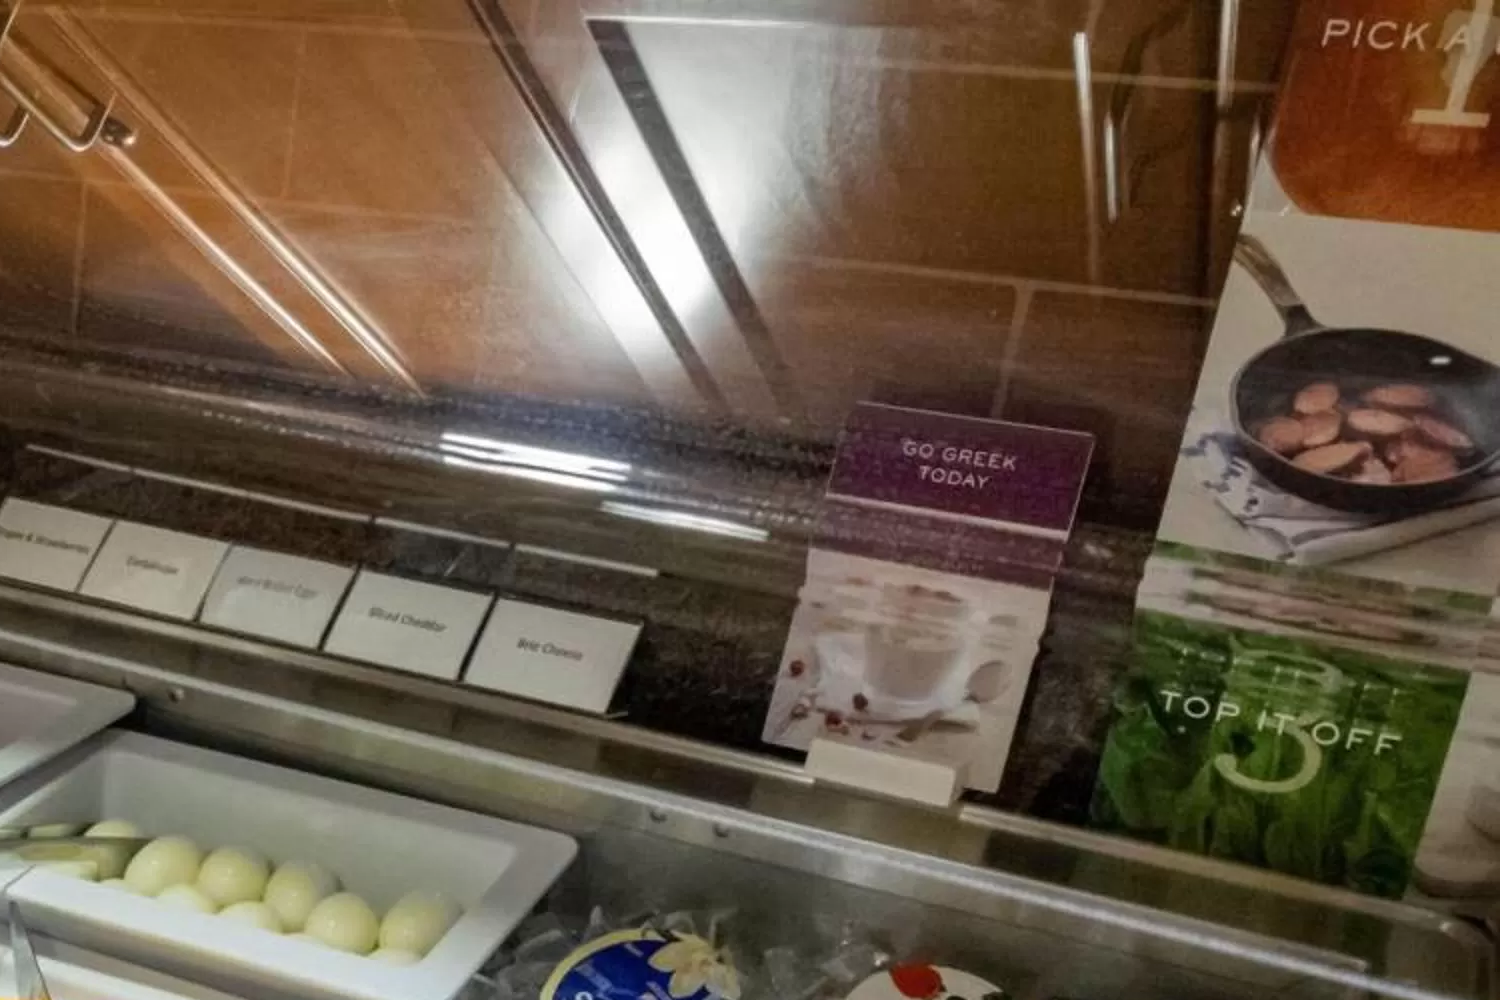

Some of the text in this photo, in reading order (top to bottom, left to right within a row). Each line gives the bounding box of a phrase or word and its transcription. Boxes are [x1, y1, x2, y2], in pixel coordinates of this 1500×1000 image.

[1321, 18, 1431, 51] PICK
[902, 439, 1017, 472] GO GREEK
[919, 465, 992, 489] TODAY
[1159, 689, 1403, 756] TOP IT OFF
